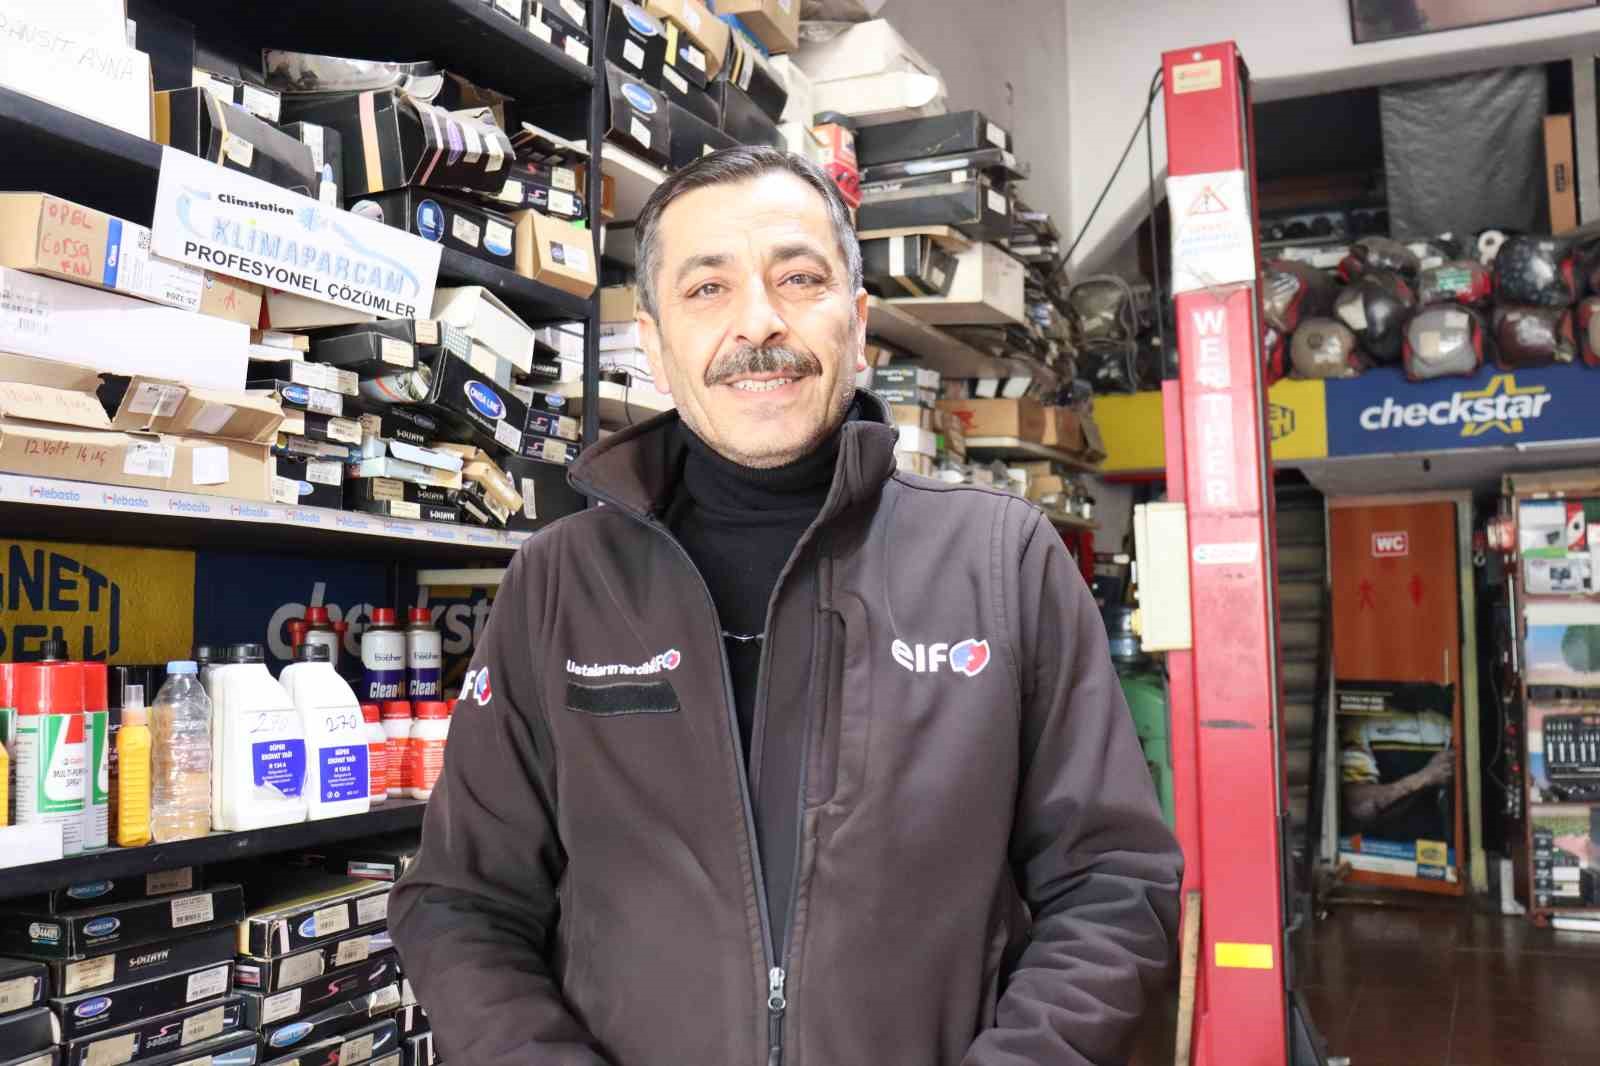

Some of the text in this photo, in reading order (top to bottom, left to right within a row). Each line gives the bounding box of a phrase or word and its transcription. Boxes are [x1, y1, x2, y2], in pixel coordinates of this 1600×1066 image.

[217, 193, 295, 216] Climstation
[184, 240, 322, 294] PROFESYONEL
[327, 281, 417, 319] ÇÖZÜMLER
[1360, 391, 1552, 430] checkstar
[24, 439, 40, 456] 12
[1376, 536, 1404, 551] WC
[325, 713, 358, 733] 270
